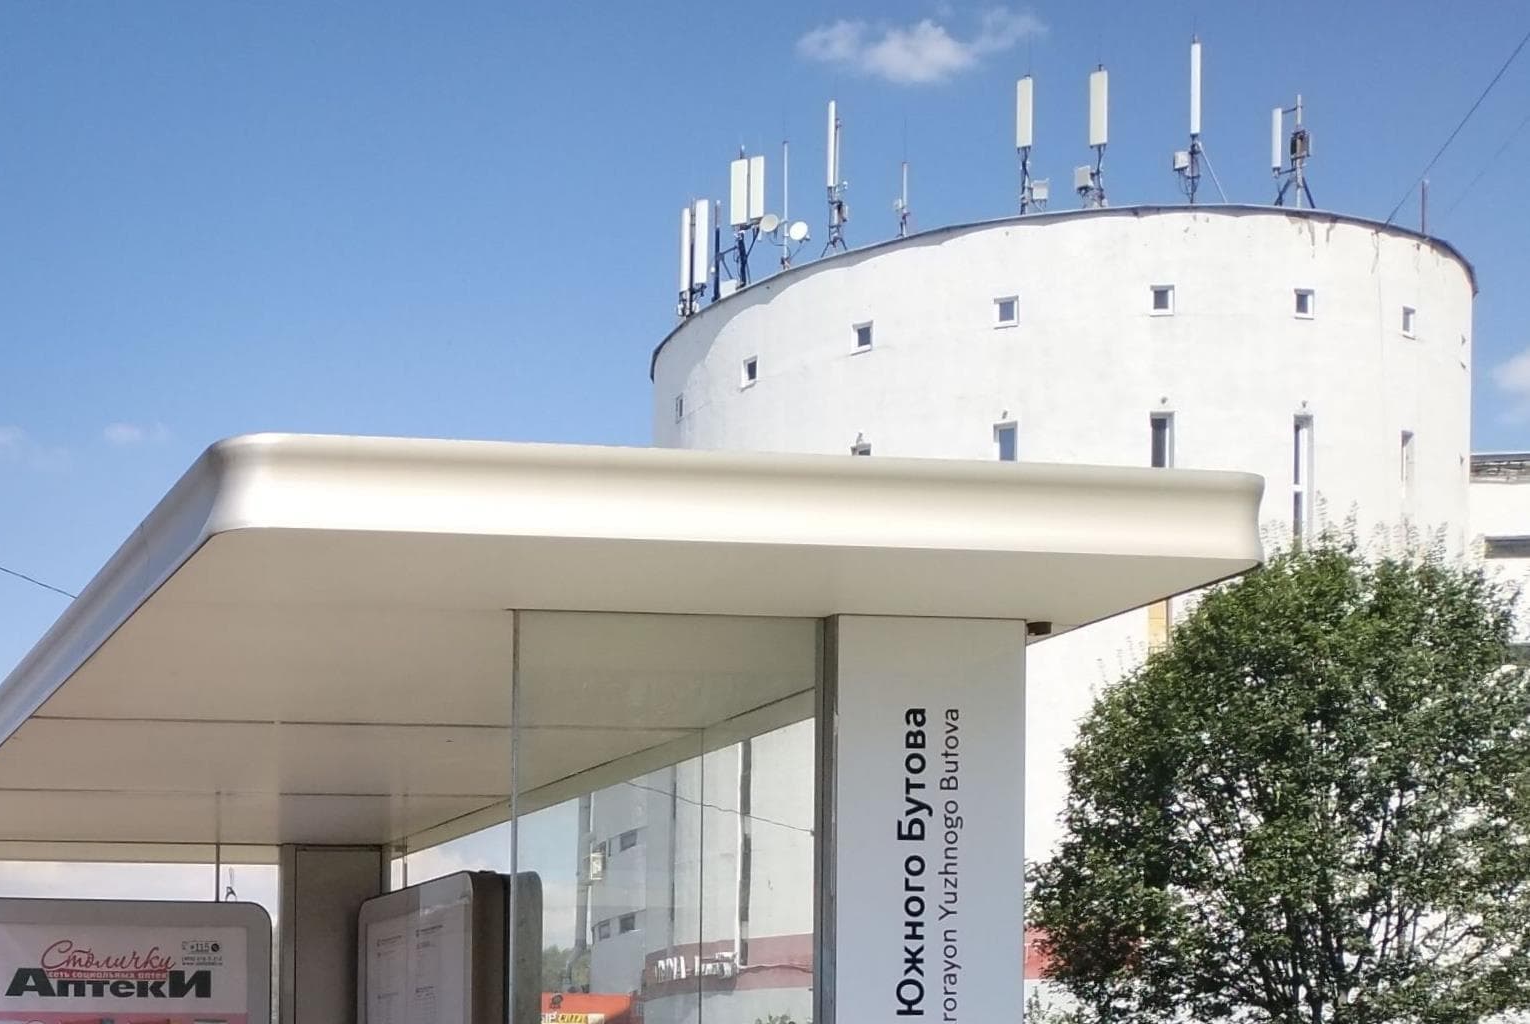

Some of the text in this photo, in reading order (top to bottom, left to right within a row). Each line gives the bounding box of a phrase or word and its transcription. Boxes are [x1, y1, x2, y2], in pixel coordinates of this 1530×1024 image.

[897, 707, 933, 841] Бутова
[940, 707, 960, 791] Butova
[938, 799, 964, 921] Yuzhnogo
[40, 939, 176, 970] Столички
[895, 854, 926, 1017] Южного
